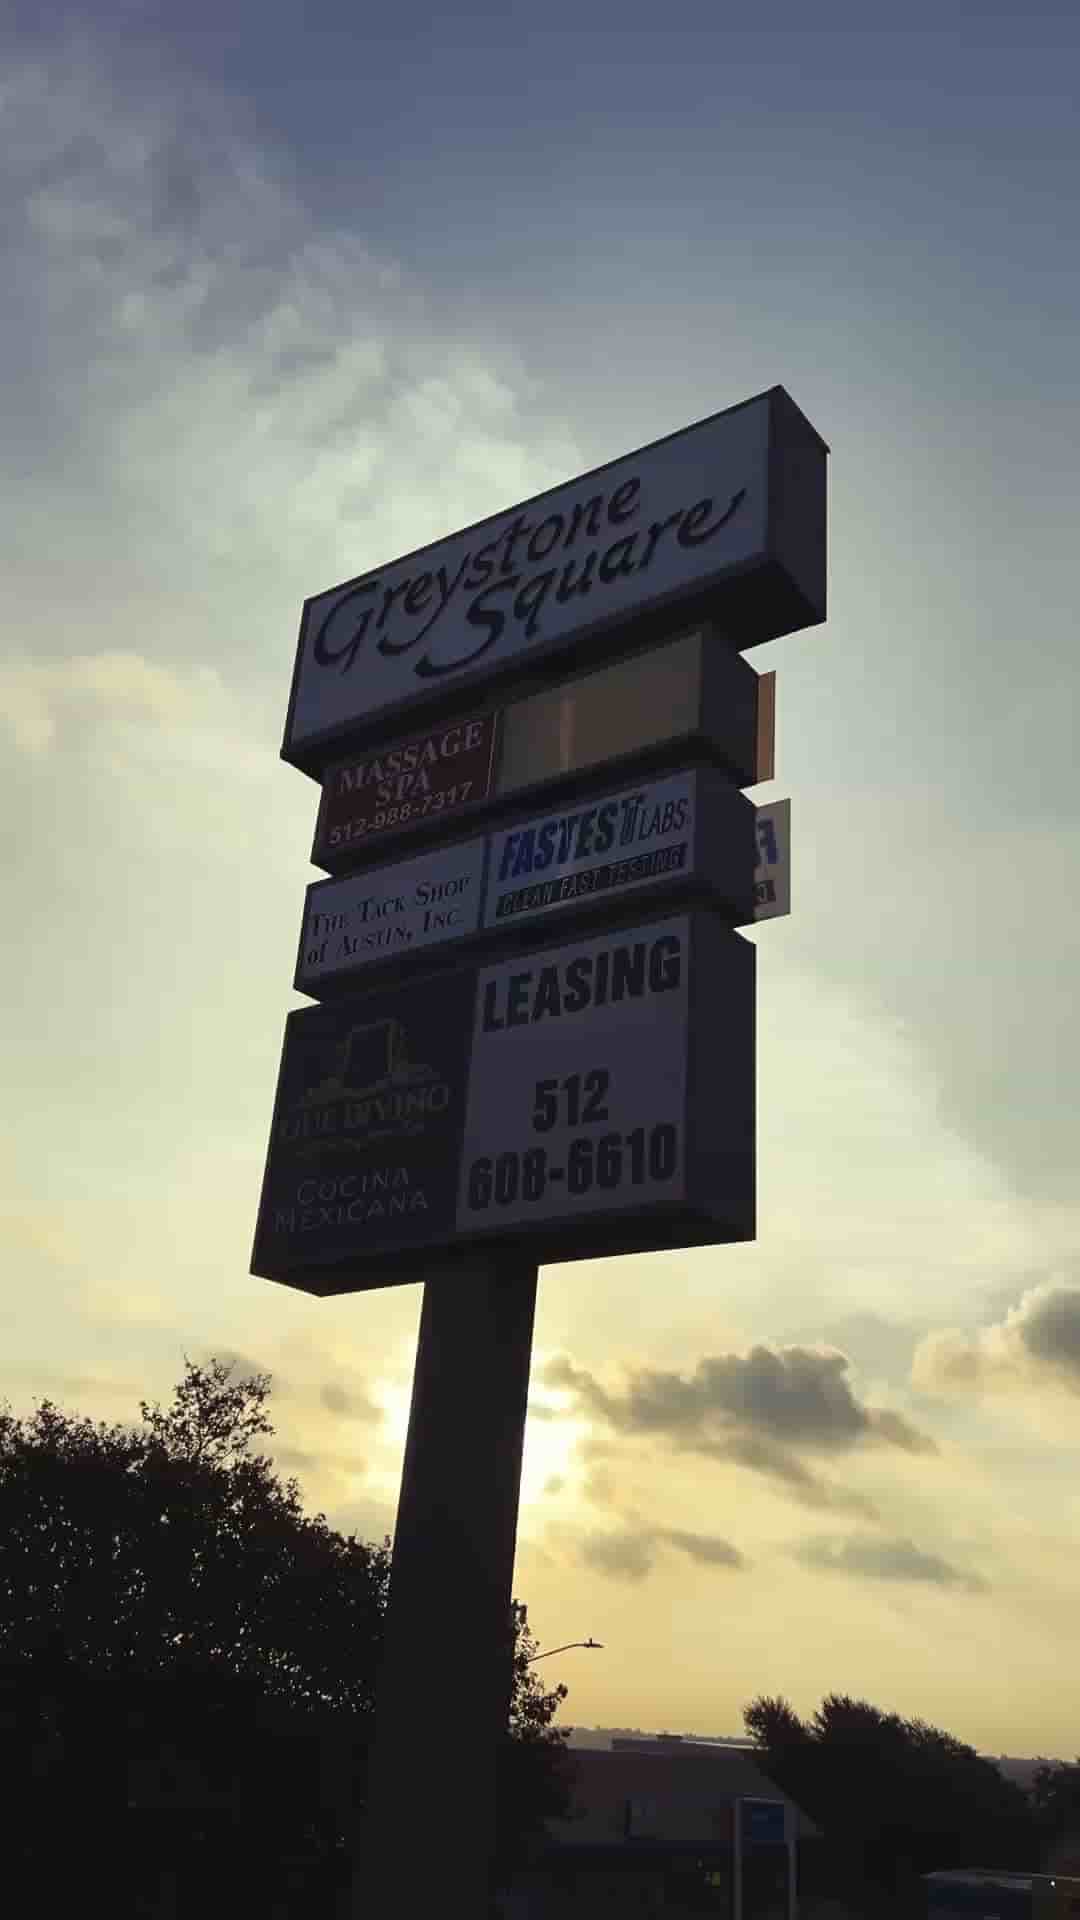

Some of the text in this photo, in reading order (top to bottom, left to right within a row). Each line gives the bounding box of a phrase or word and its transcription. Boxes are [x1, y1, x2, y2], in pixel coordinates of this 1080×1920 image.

[314, 477, 640, 675] Greystone
[416, 489, 747, 679] Square
[338, 720, 485, 792] MASSAGE
[375, 766, 431, 808] SPA
[328, 780, 473, 846] 512-988-7317
[639, 798, 688, 836] LABS
[559, 867, 602, 902] FAST
[607, 845, 687, 887] TESTING
[483, 937, 681, 1032] LEASING
[533, 1070, 610, 1132] 512
[296, 1168, 410, 1205] COCINA
[468, 1126, 677, 1209] 608-6610
[273, 1191, 429, 1233] MEXICANA
